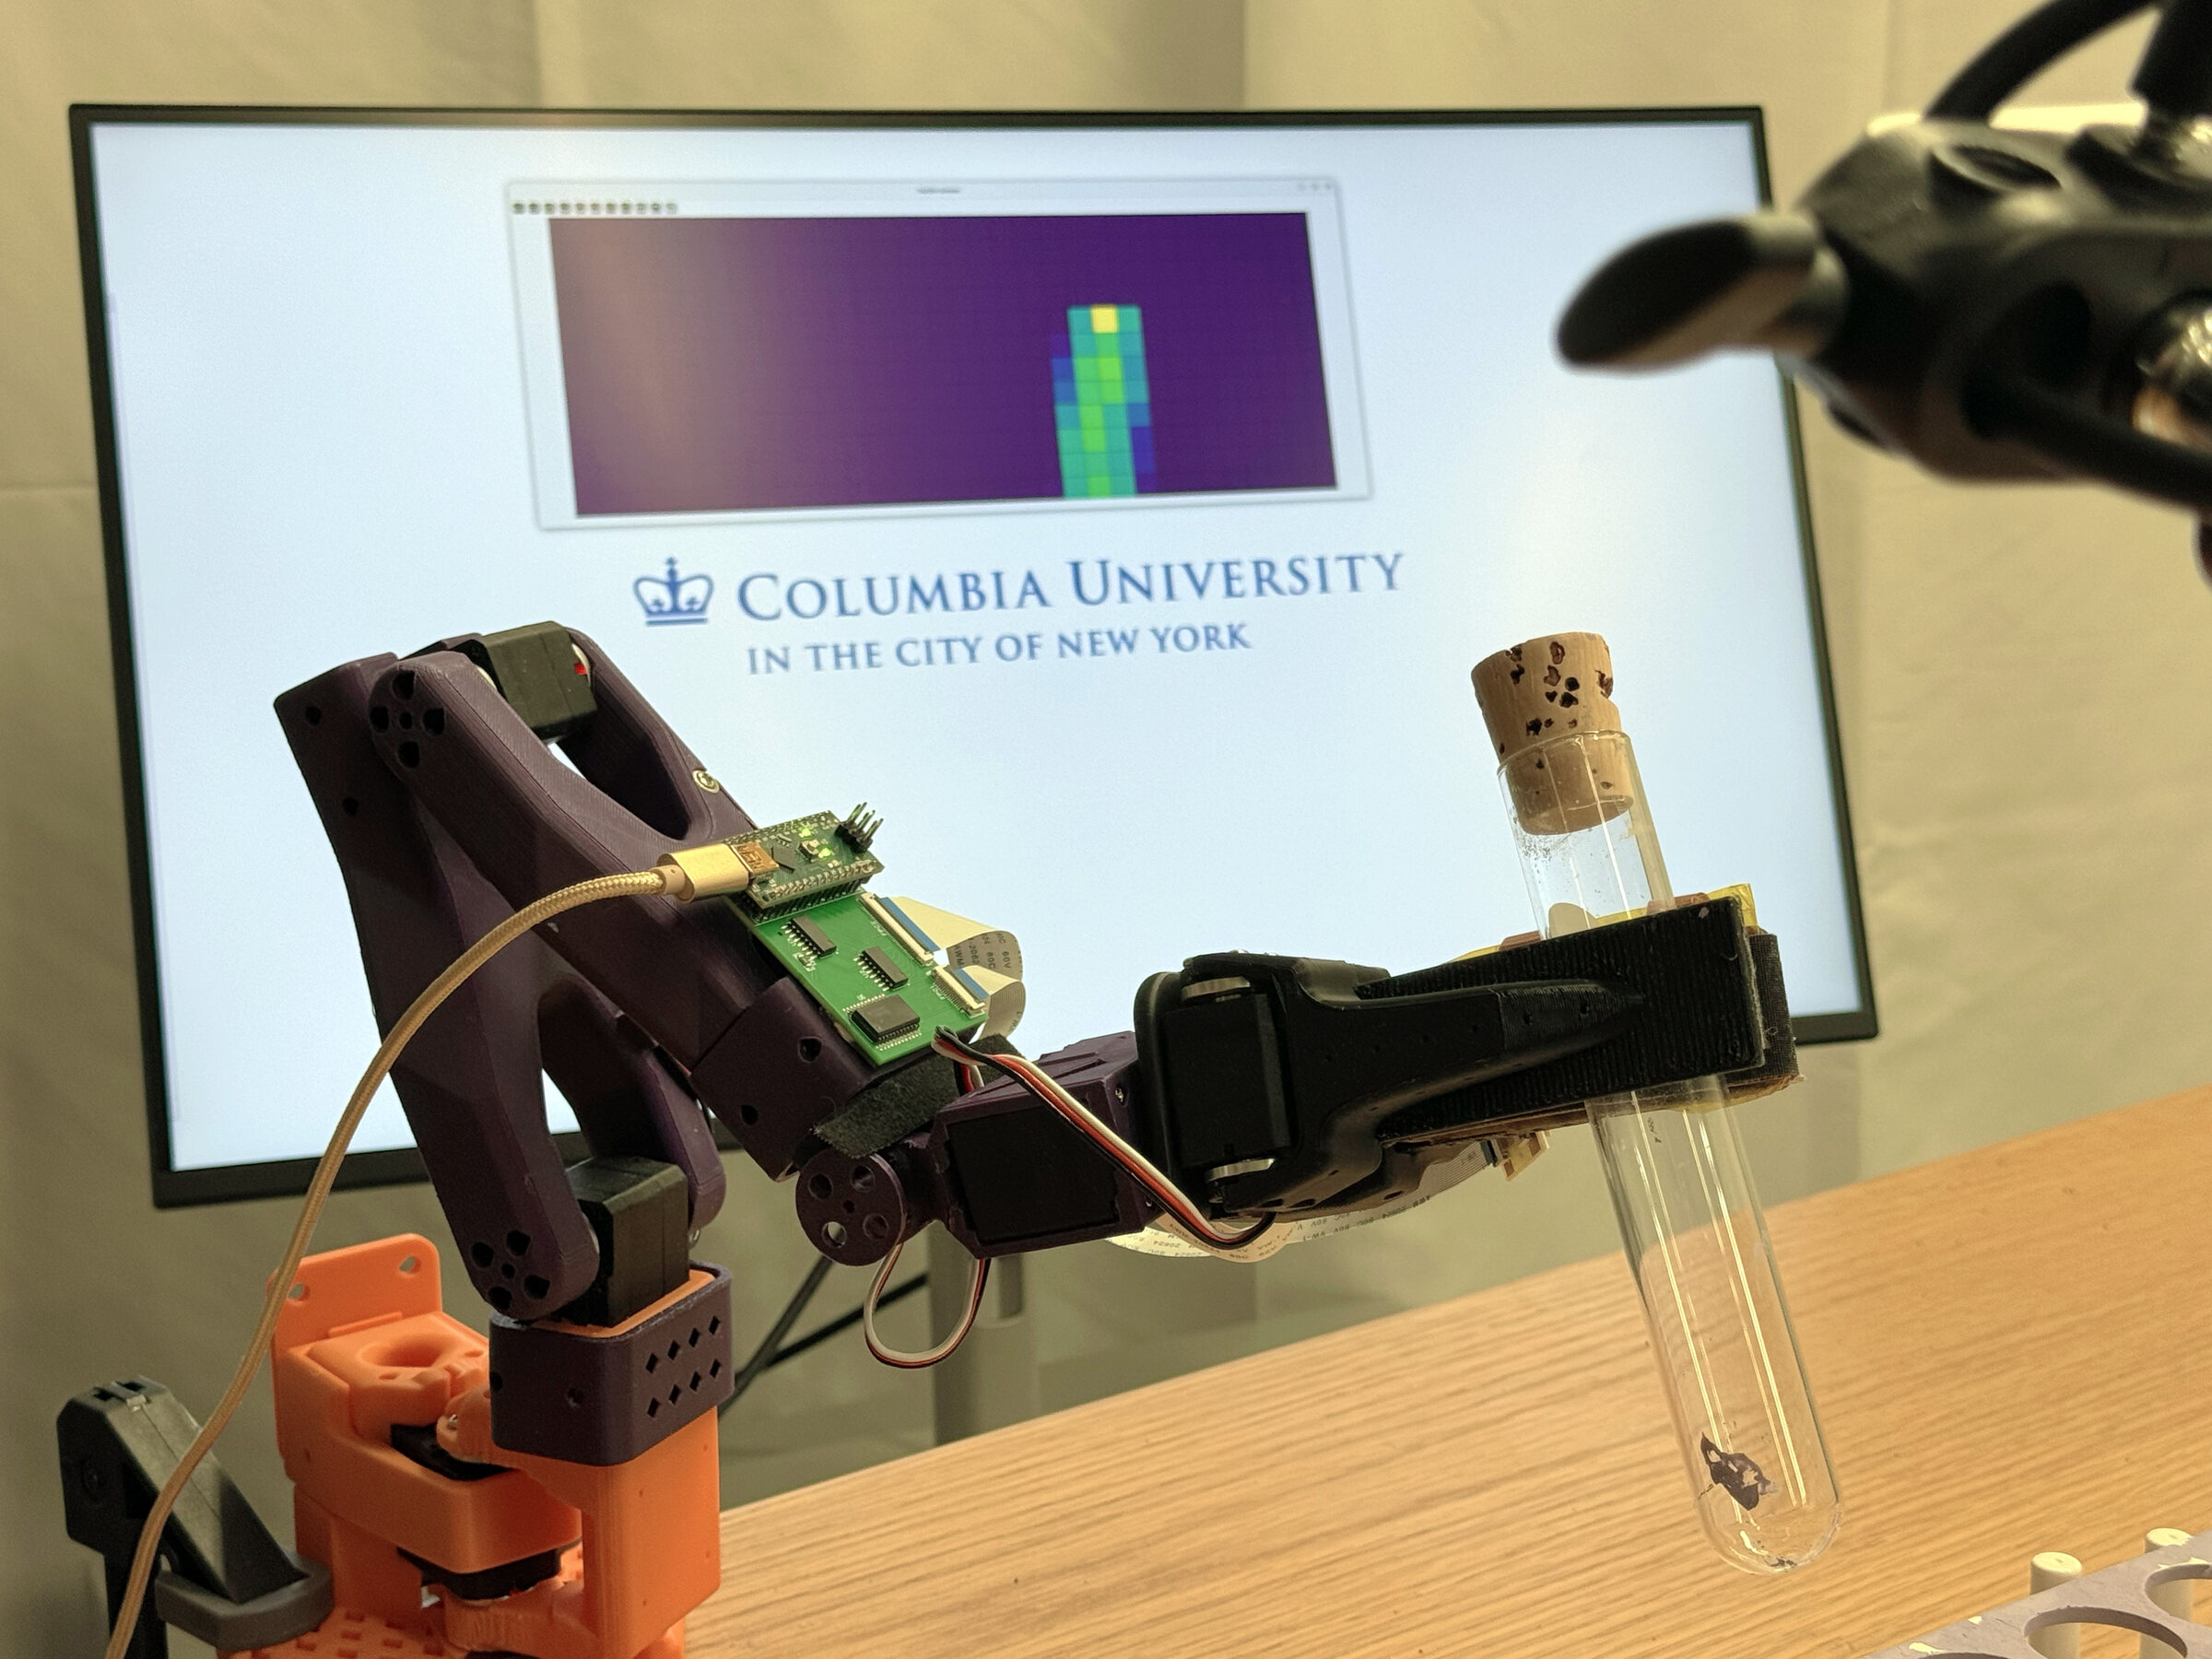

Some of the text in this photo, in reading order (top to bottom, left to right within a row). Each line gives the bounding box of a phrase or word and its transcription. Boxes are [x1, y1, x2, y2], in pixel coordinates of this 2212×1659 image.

[736, 552, 1406, 621] COLUMBIA UNIVERSITY
[747, 622, 1253, 675] IN THE CITY OF NEW YORK
